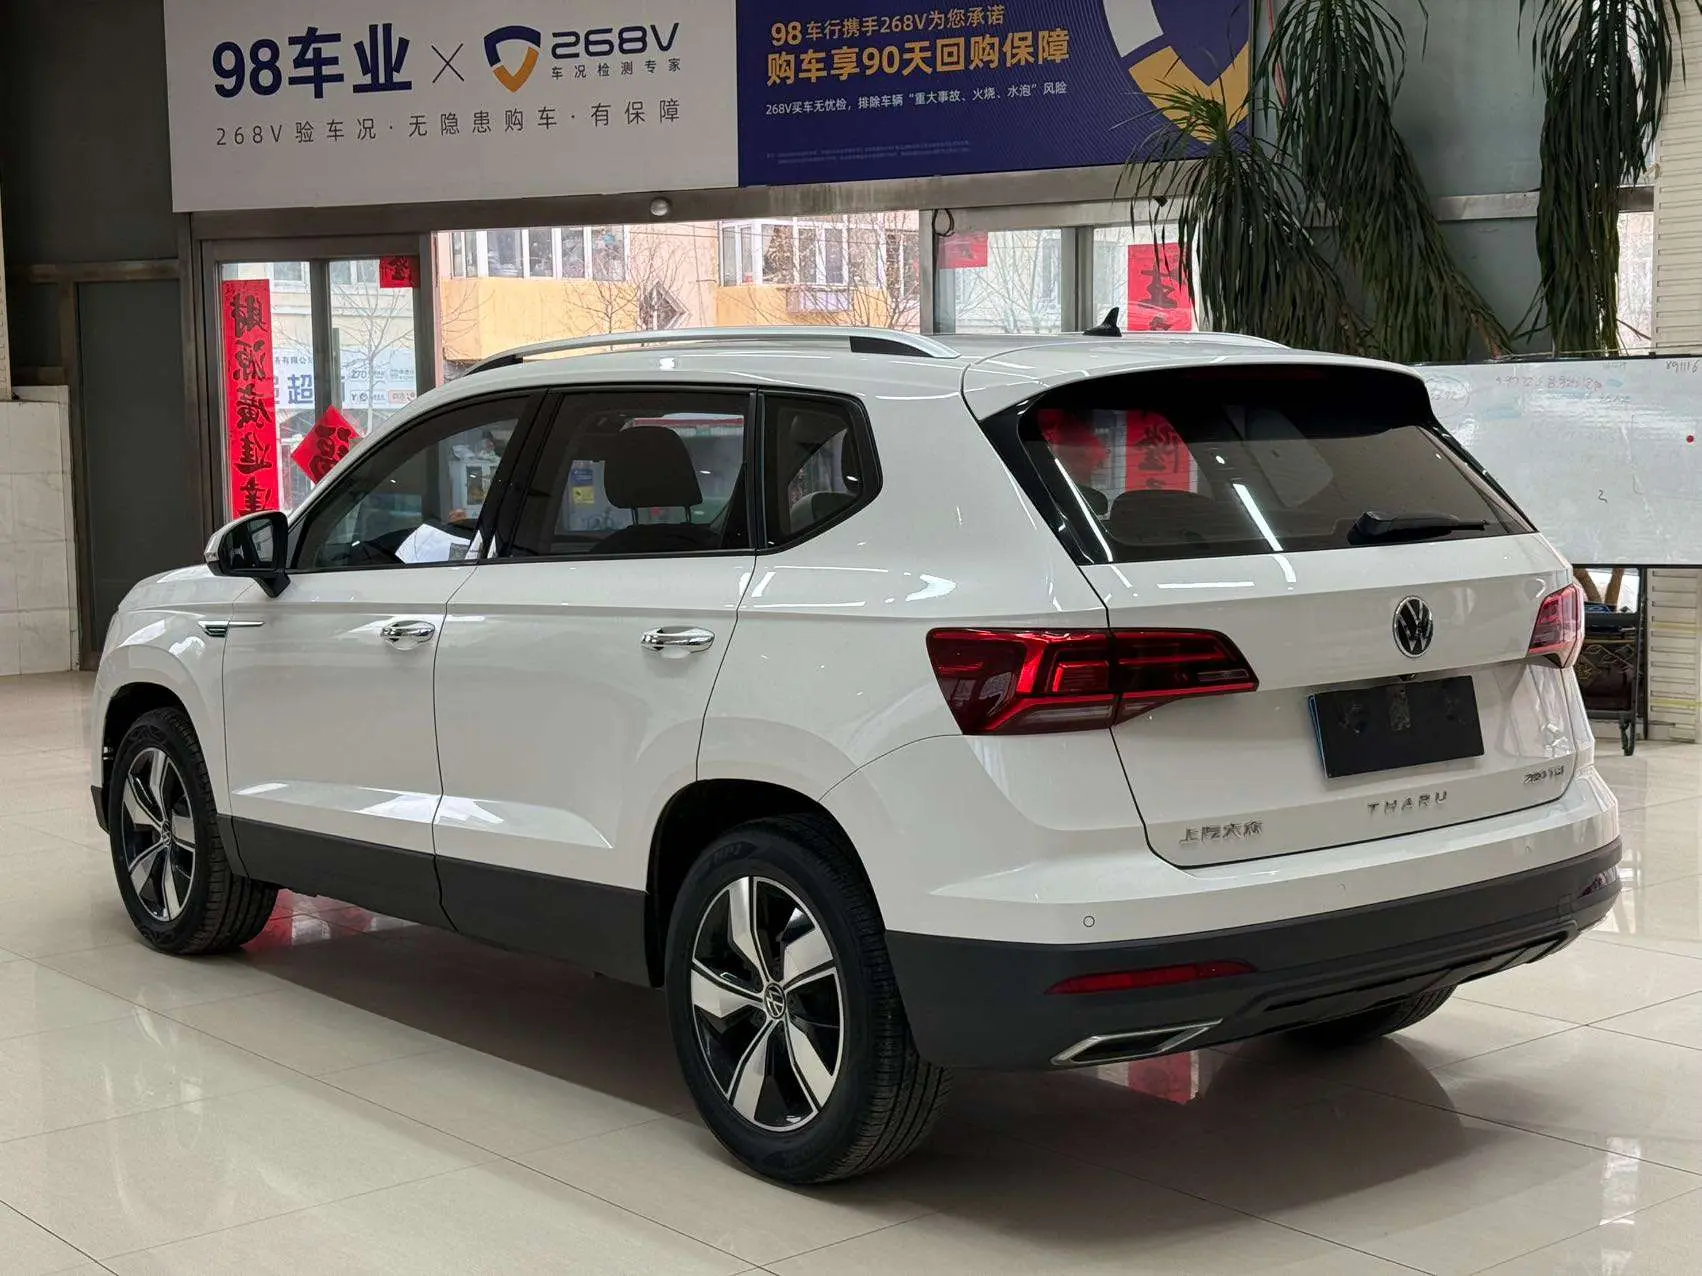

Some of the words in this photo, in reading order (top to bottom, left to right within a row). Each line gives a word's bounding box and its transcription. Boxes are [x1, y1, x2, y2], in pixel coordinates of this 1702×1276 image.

[771, 4, 1005, 46] 98车行携手268V为您承诺
[212, 23, 412, 98] 98车业
[551, 23, 680, 60] 268V
[551, 58, 681, 80] 车况检测专家
[766, 28, 1070, 87] 购车享90天回购保障
[1367, 790, 1448, 816] THARU
